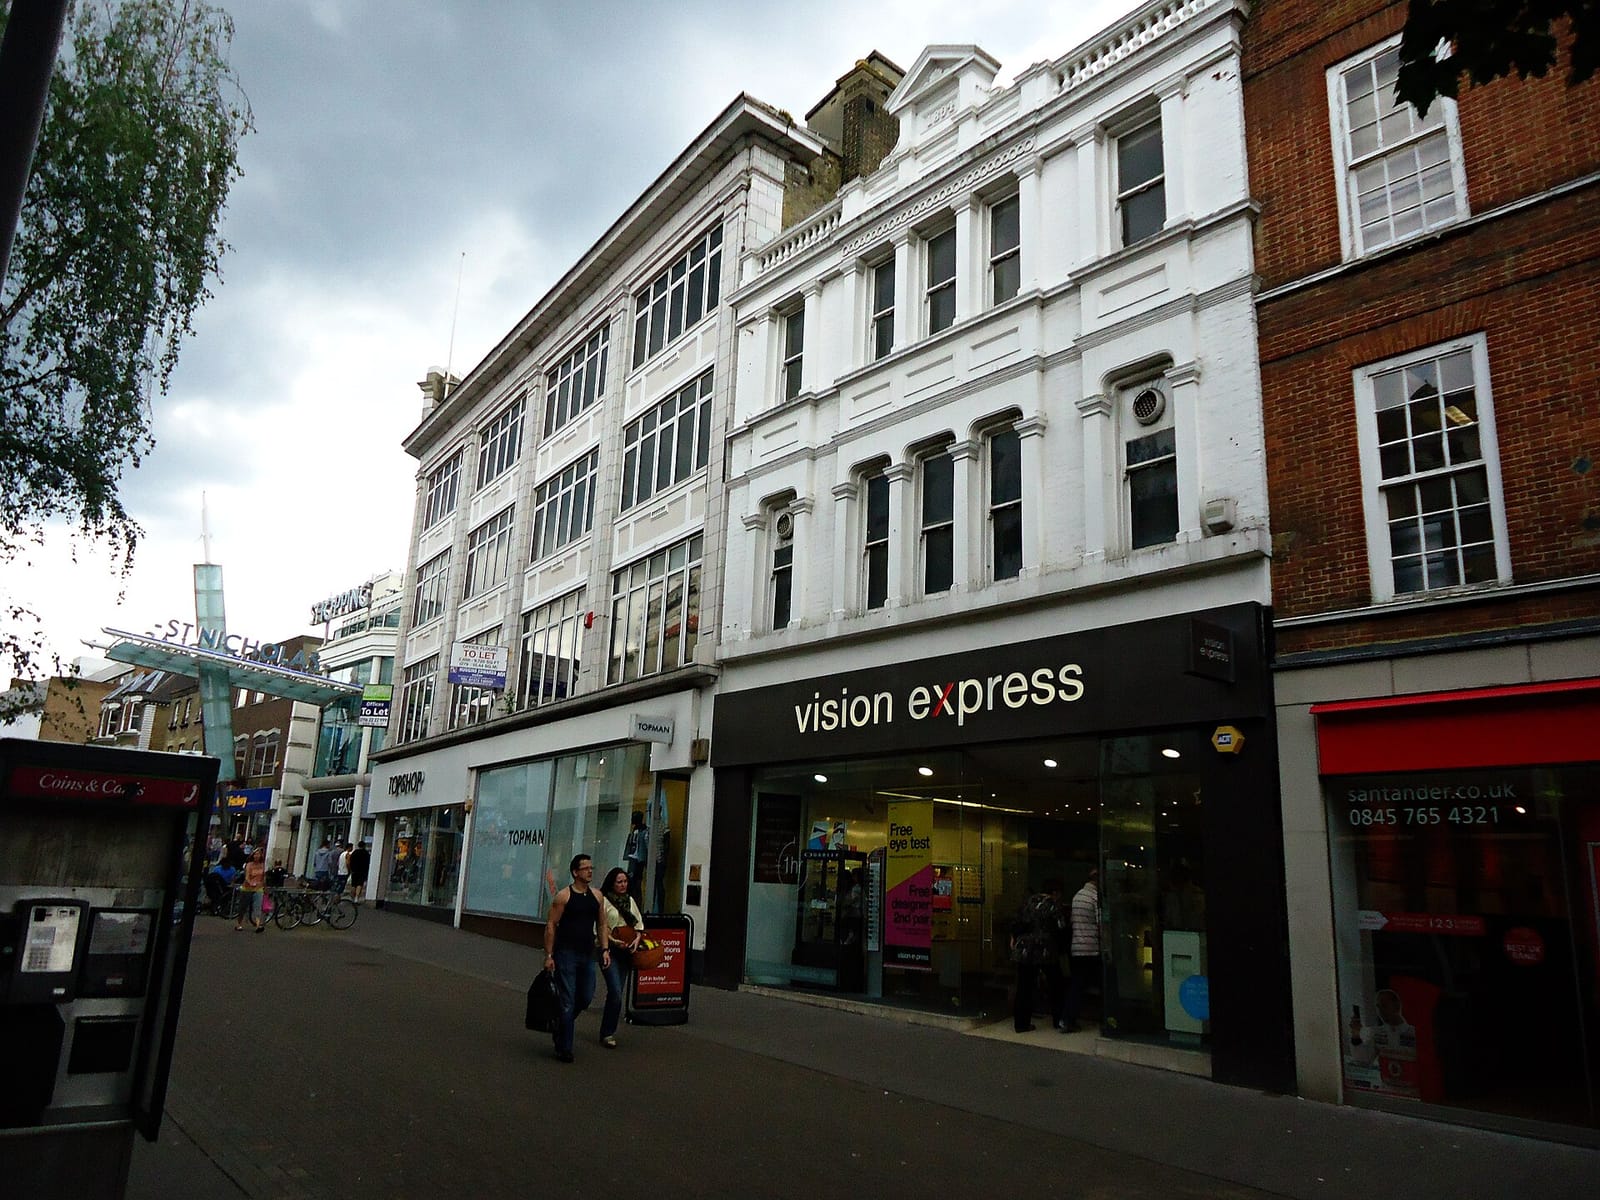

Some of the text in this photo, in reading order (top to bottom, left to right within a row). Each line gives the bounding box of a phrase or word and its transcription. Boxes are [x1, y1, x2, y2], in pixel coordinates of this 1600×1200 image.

[167, 619, 320, 671] ST NICHOLAS
[463, 650, 476, 658] TO
[479, 652, 497, 660] LET
[794, 663, 1085, 734] vision express
[361, 707, 389, 716] To Let
[638, 722, 670, 733] TOPMAN
[39, 773, 146, 797] Coins & Cas
[388, 771, 423, 797] TOPSHOP
[1347, 784, 1517, 802] santander.co.uk
[1349, 806, 1500, 826] 0845 765 4321
[889, 823, 913, 836] Free
[508, 829, 545, 846] TOPMAN
[889, 837, 930, 853] eye test
[908, 885, 930, 898] Free
[891, 899, 930, 914] designer
[893, 913, 911, 924] 2nd
[911, 953, 930, 961] epress
